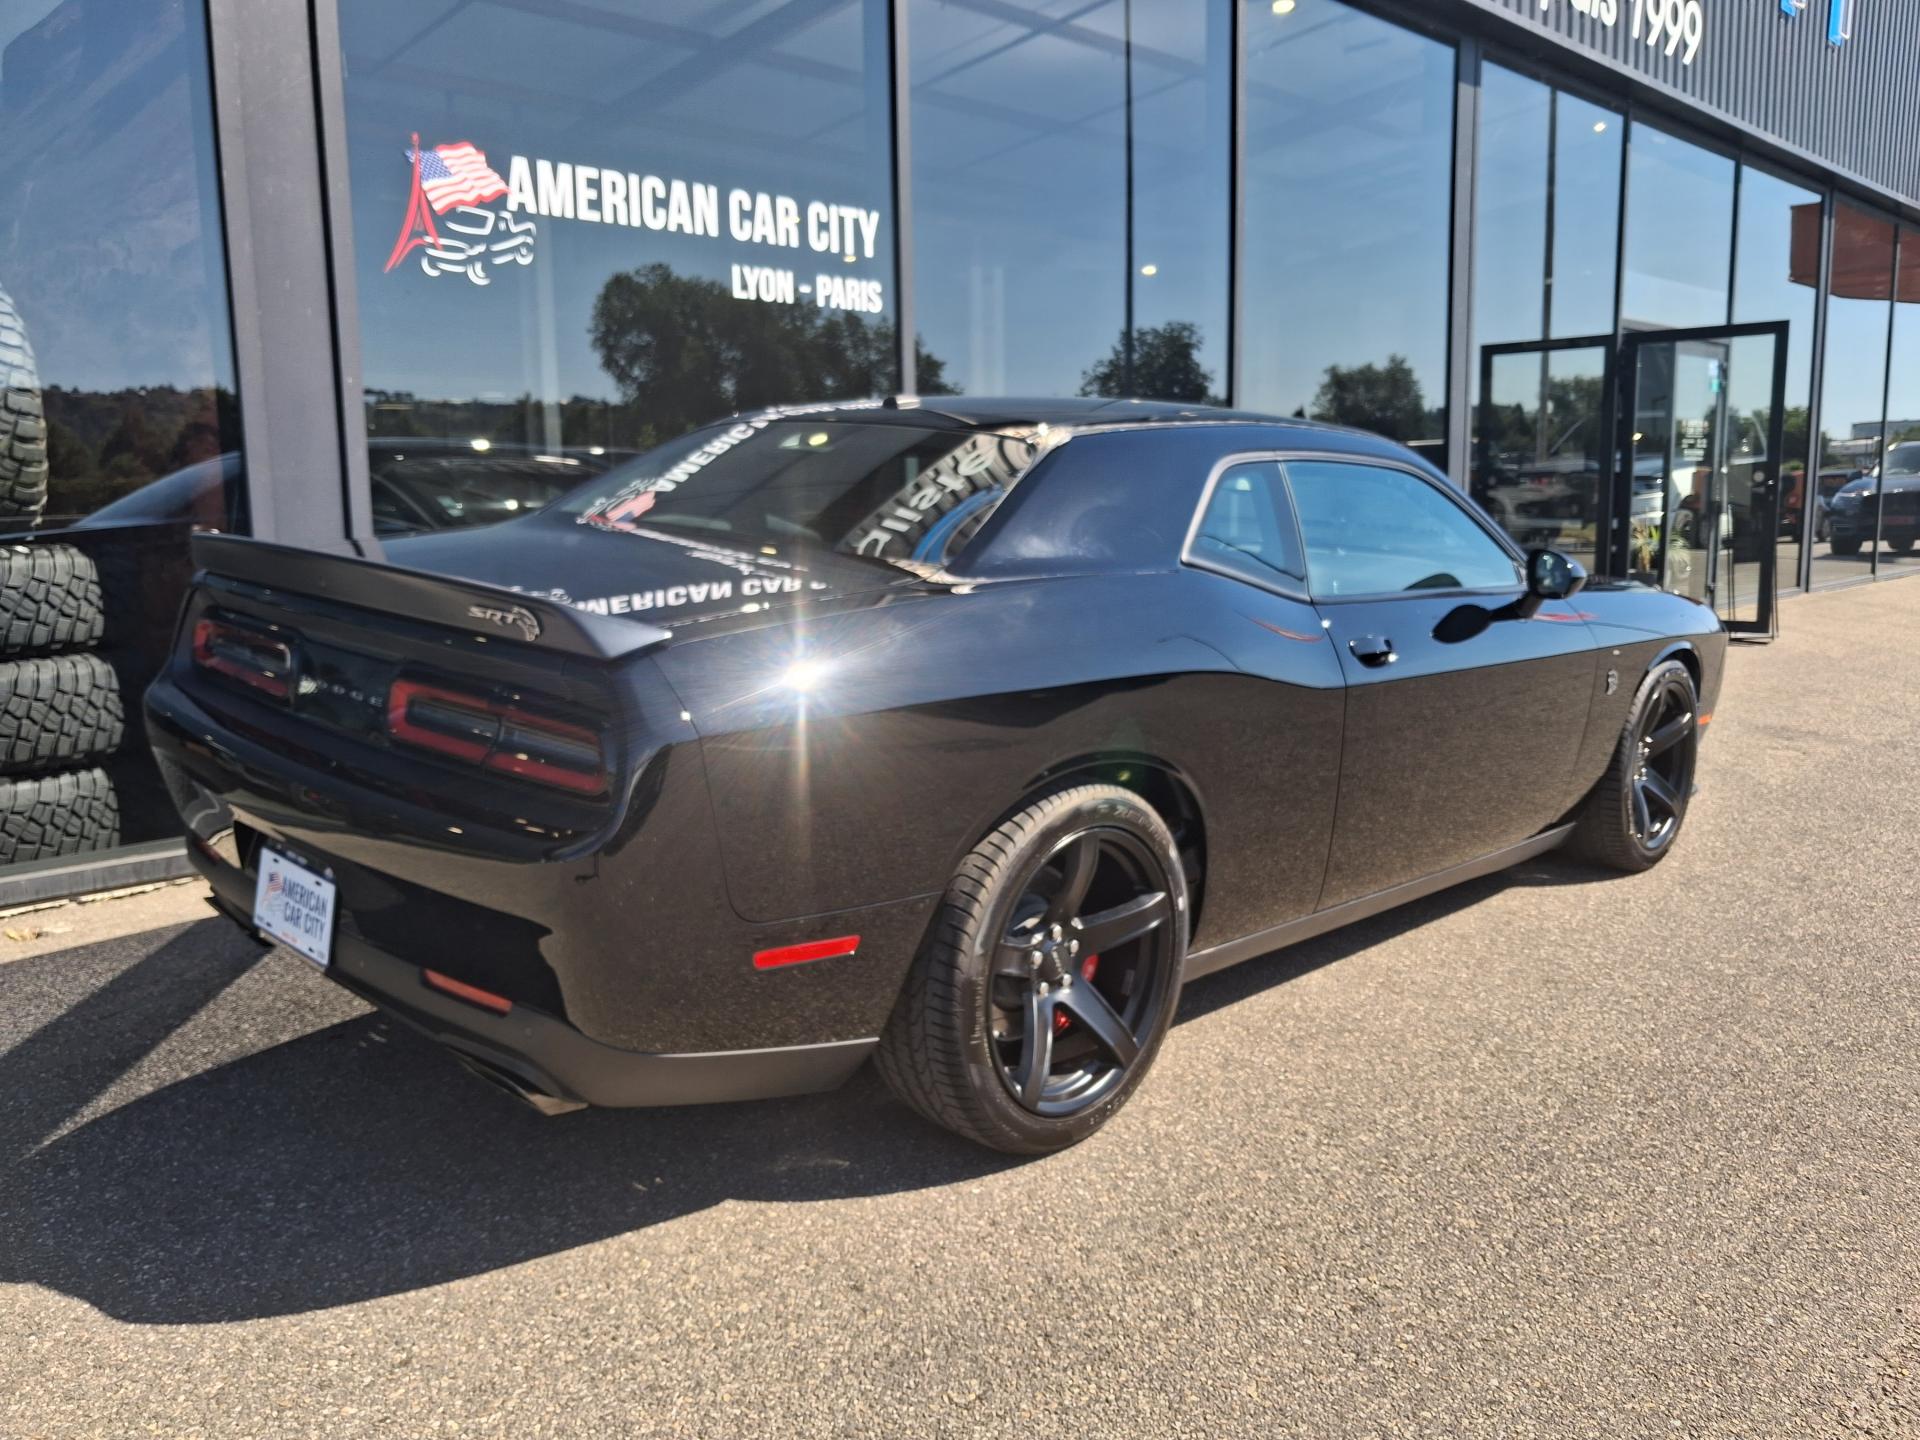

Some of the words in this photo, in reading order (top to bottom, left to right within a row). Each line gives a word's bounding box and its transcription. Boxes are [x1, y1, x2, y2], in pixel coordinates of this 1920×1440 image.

[1630, 0, 1702, 65] 1999
[507, 155, 719, 238] AMERICAN
[729, 188, 800, 248] CAR
[807, 200, 880, 258] CITY
[731, 263, 795, 304] LYON
[815, 273, 883, 313] PARIS
[468, 606, 515, 626] SRT
[281, 876, 328, 918] AMERICAN
[284, 901, 301, 927] CAR
[304, 911, 326, 941] CITY
